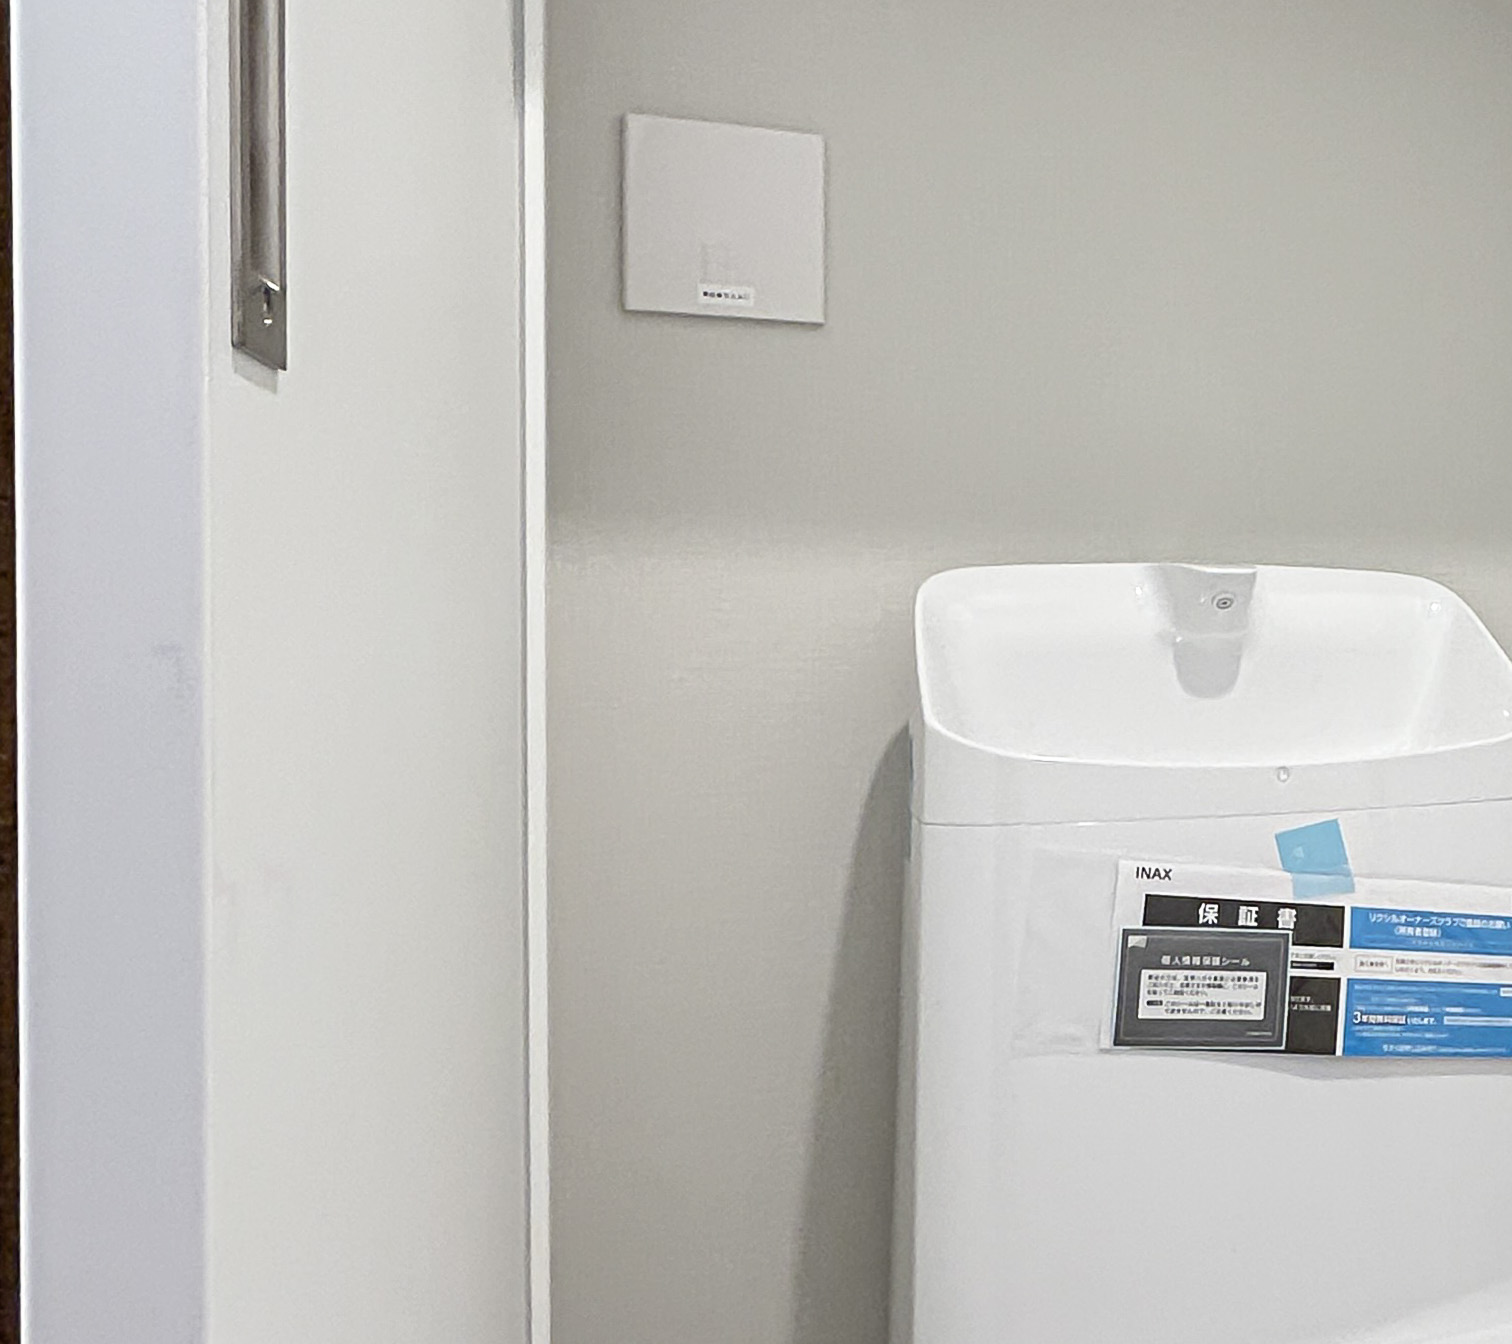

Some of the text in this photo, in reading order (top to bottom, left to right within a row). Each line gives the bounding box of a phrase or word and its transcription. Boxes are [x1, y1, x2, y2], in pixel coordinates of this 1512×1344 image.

[1135, 866, 1173, 881] INAX
[1198, 902, 1298, 930] 保証書
